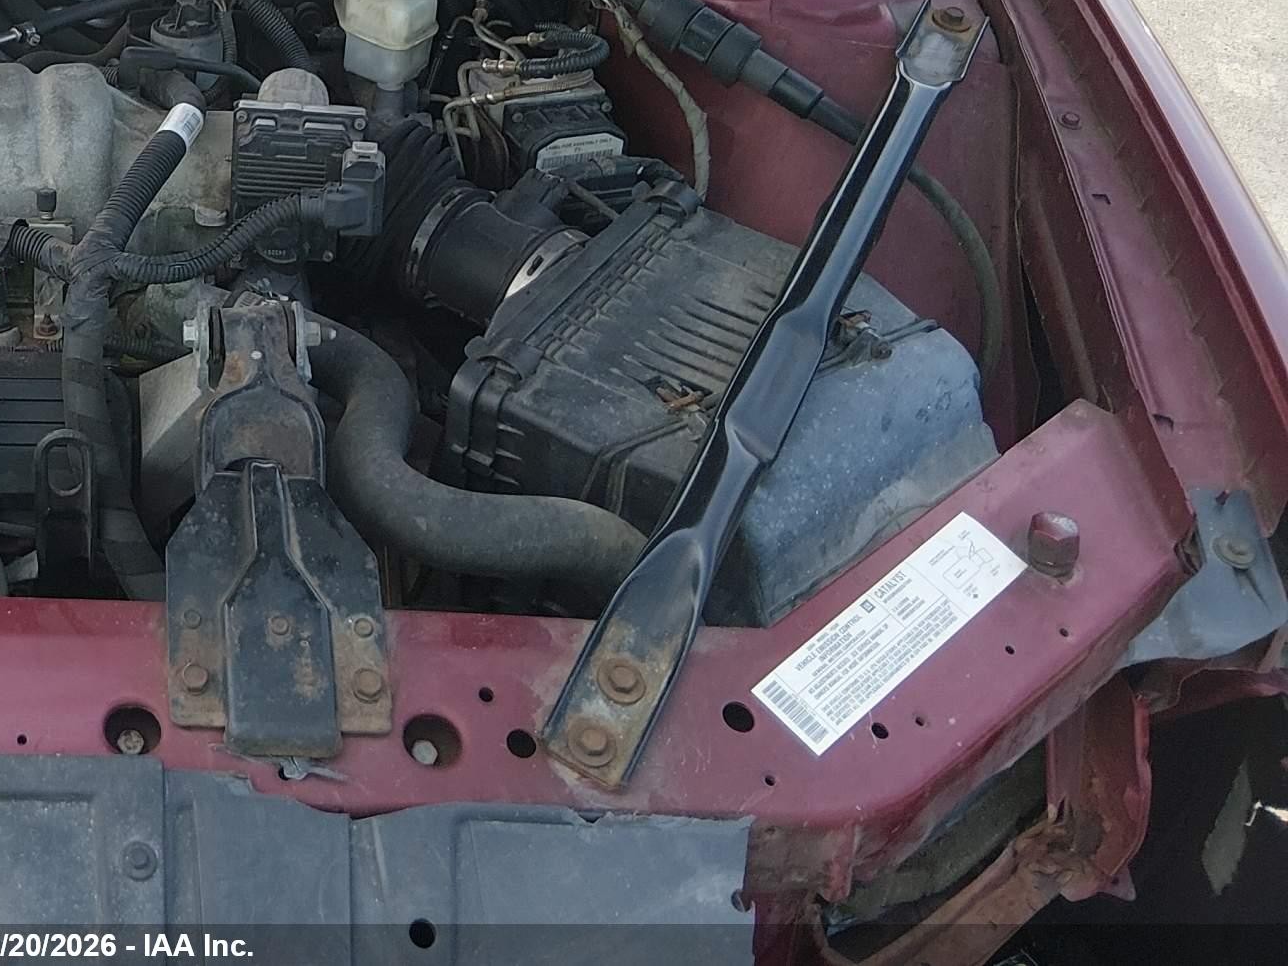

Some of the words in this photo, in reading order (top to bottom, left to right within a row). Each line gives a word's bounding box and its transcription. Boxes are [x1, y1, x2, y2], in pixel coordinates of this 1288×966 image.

[872, 569, 907, 599] CATALYST
[794, 651, 817, 671] VEHICLE
[814, 631, 840, 654] EMISSION
[837, 613, 862, 634] CONTROL
[817, 631, 852, 662] INFORMATION
